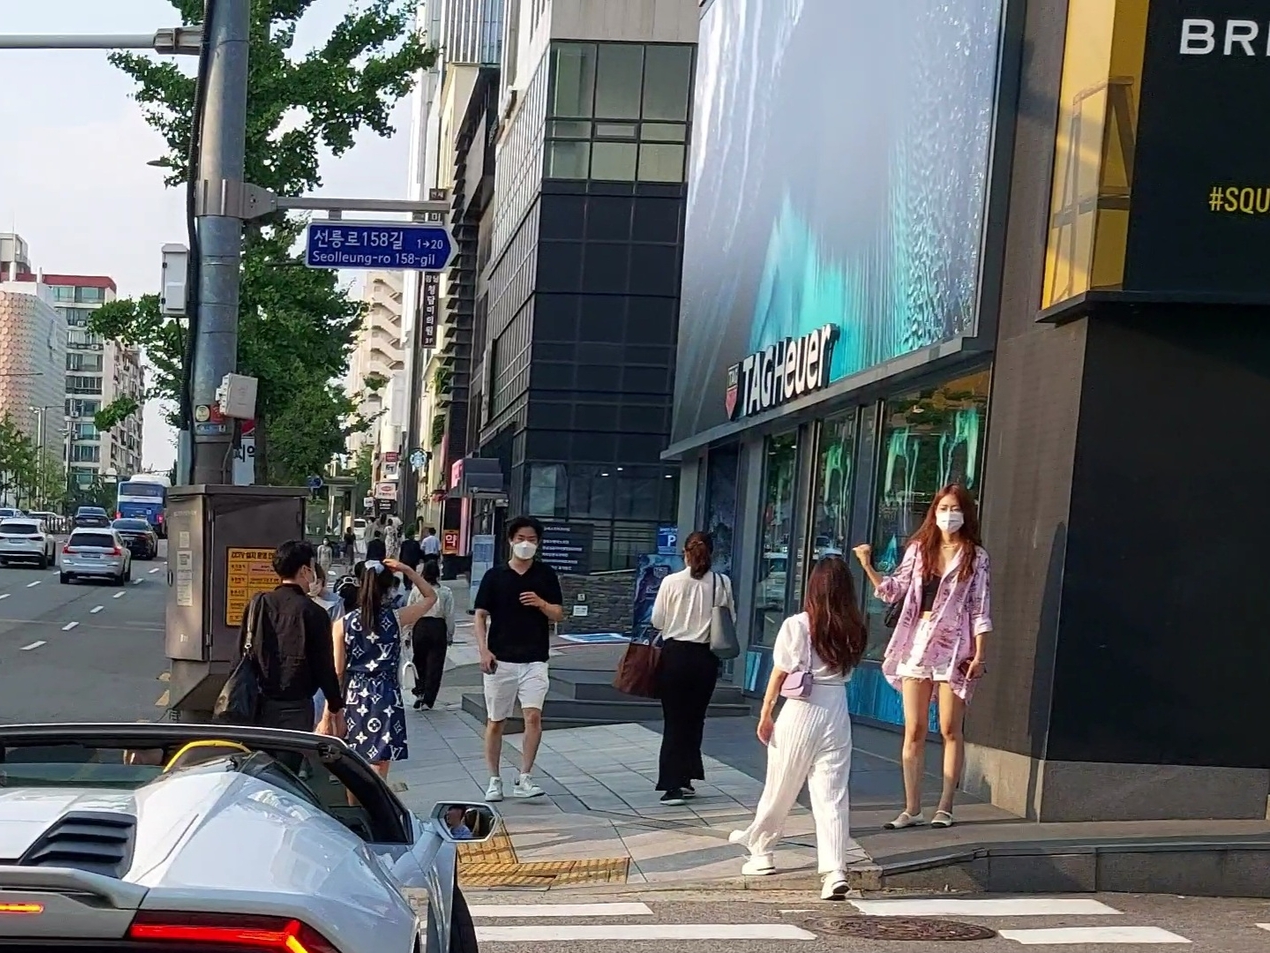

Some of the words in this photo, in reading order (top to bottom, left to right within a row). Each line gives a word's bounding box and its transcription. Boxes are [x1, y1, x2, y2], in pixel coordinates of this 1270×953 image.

[1180, 18, 1270, 57] BR
[1208, 186, 1270, 215] #SQU
[313, 229, 404, 250] 선릉로158길
[312, 250, 391, 266] Seolleung-ro
[395, 252, 436, 267] 158-gil
[445, 534, 457, 547] 약
[667, 534, 677, 547] P
